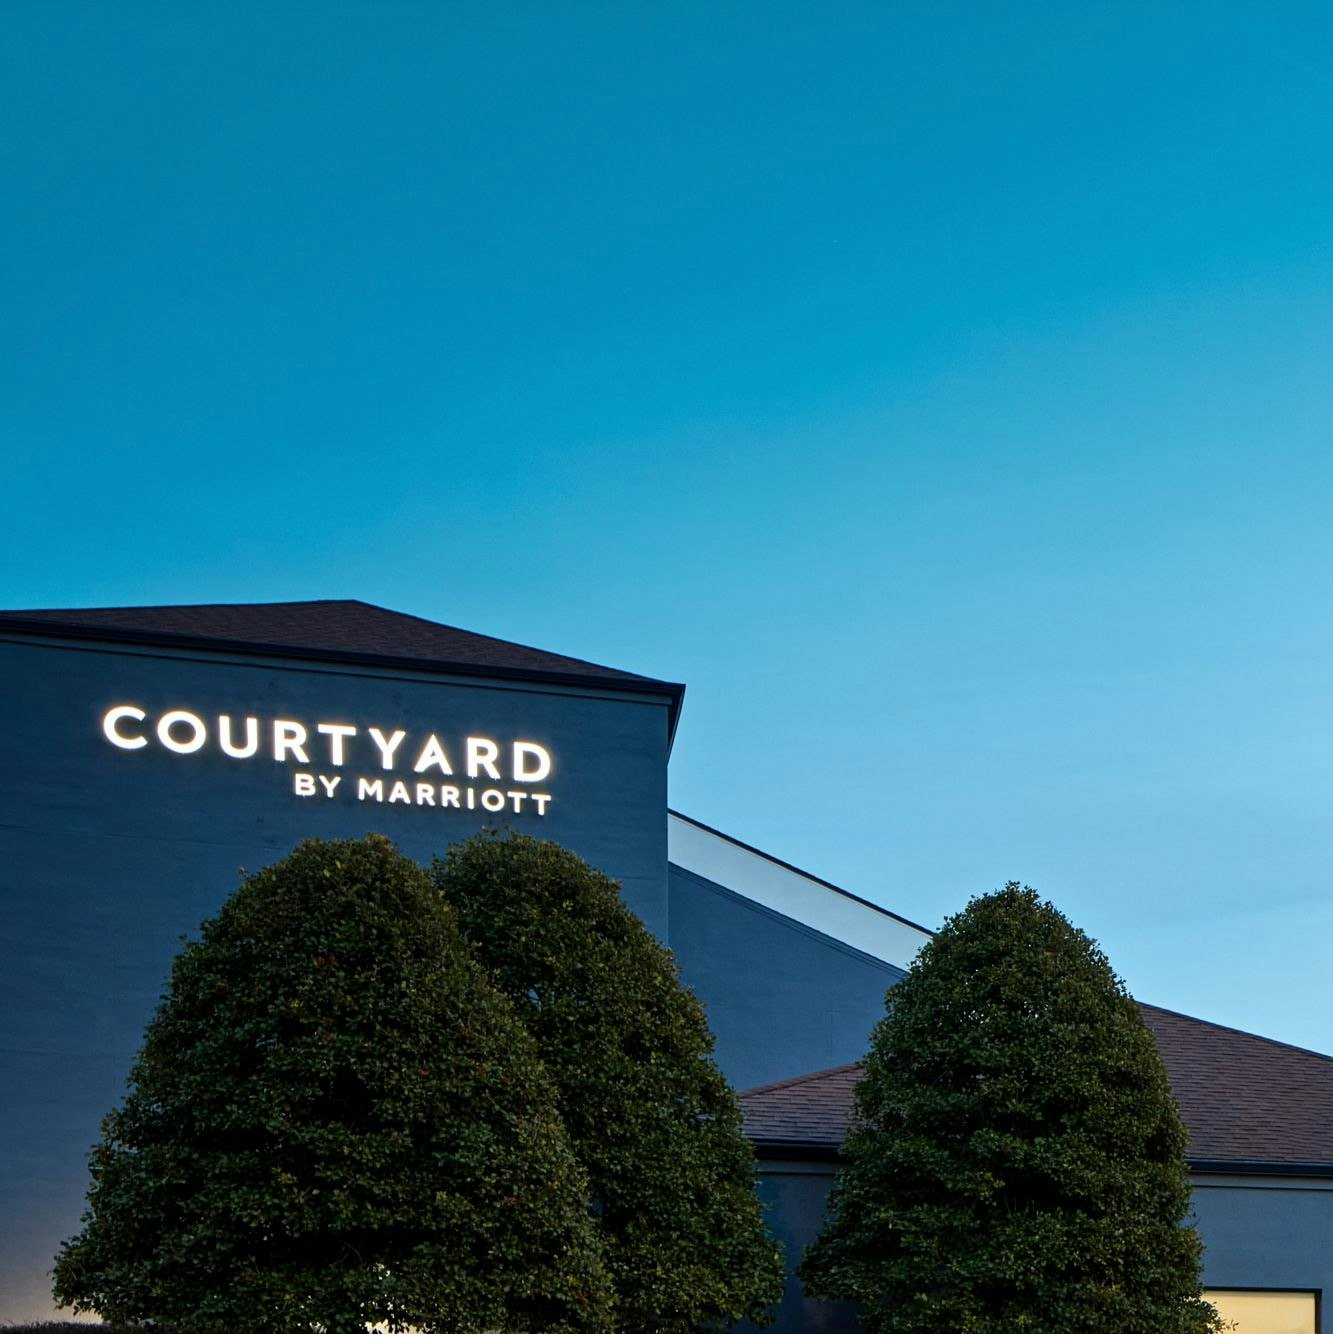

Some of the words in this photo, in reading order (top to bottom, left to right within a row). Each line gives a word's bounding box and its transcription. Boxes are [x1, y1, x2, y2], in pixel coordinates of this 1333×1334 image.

[103, 706, 552, 783] COURTYARD
[295, 773, 341, 798] BY
[358, 778, 552, 816] MARRIOTT
